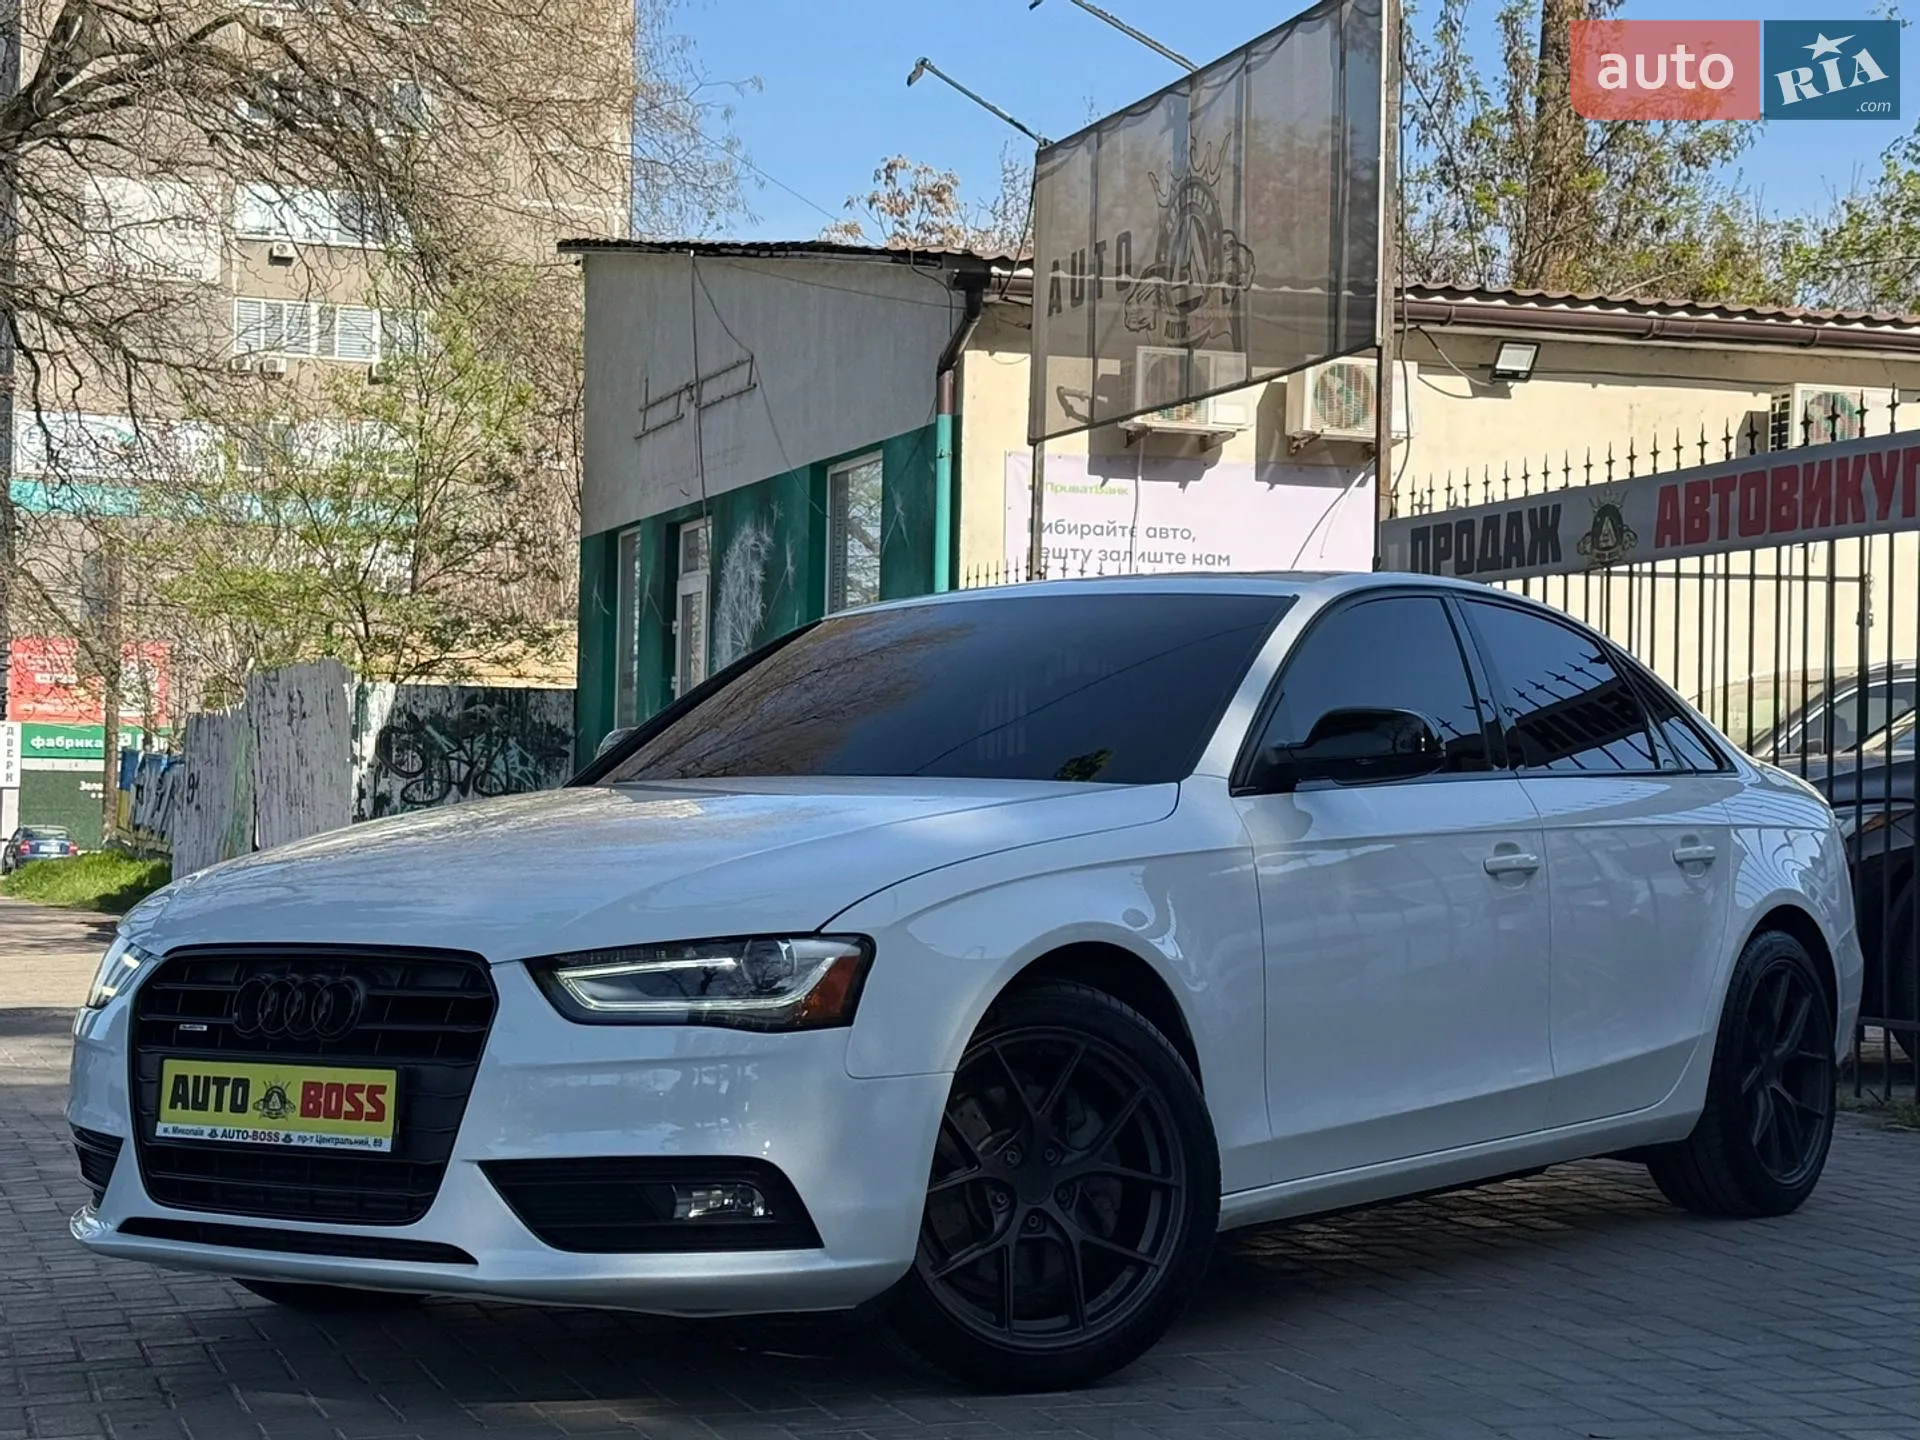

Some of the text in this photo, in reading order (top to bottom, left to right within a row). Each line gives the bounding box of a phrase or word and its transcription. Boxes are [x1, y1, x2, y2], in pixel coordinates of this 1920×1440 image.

[1047, 229, 1132, 317] AUTO
[1027, 518, 1197, 543] ибирайте авто,
[1410, 503, 1562, 576] ПРОДАЖ
[1027, 546, 1093, 564] ешту
[1192, 553, 1231, 567] нам
[30, 735, 104, 751] фабрика
[168, 1074, 388, 1123] AUTO BOSS
[219, 1128, 281, 1143] AUTO-BOSS
